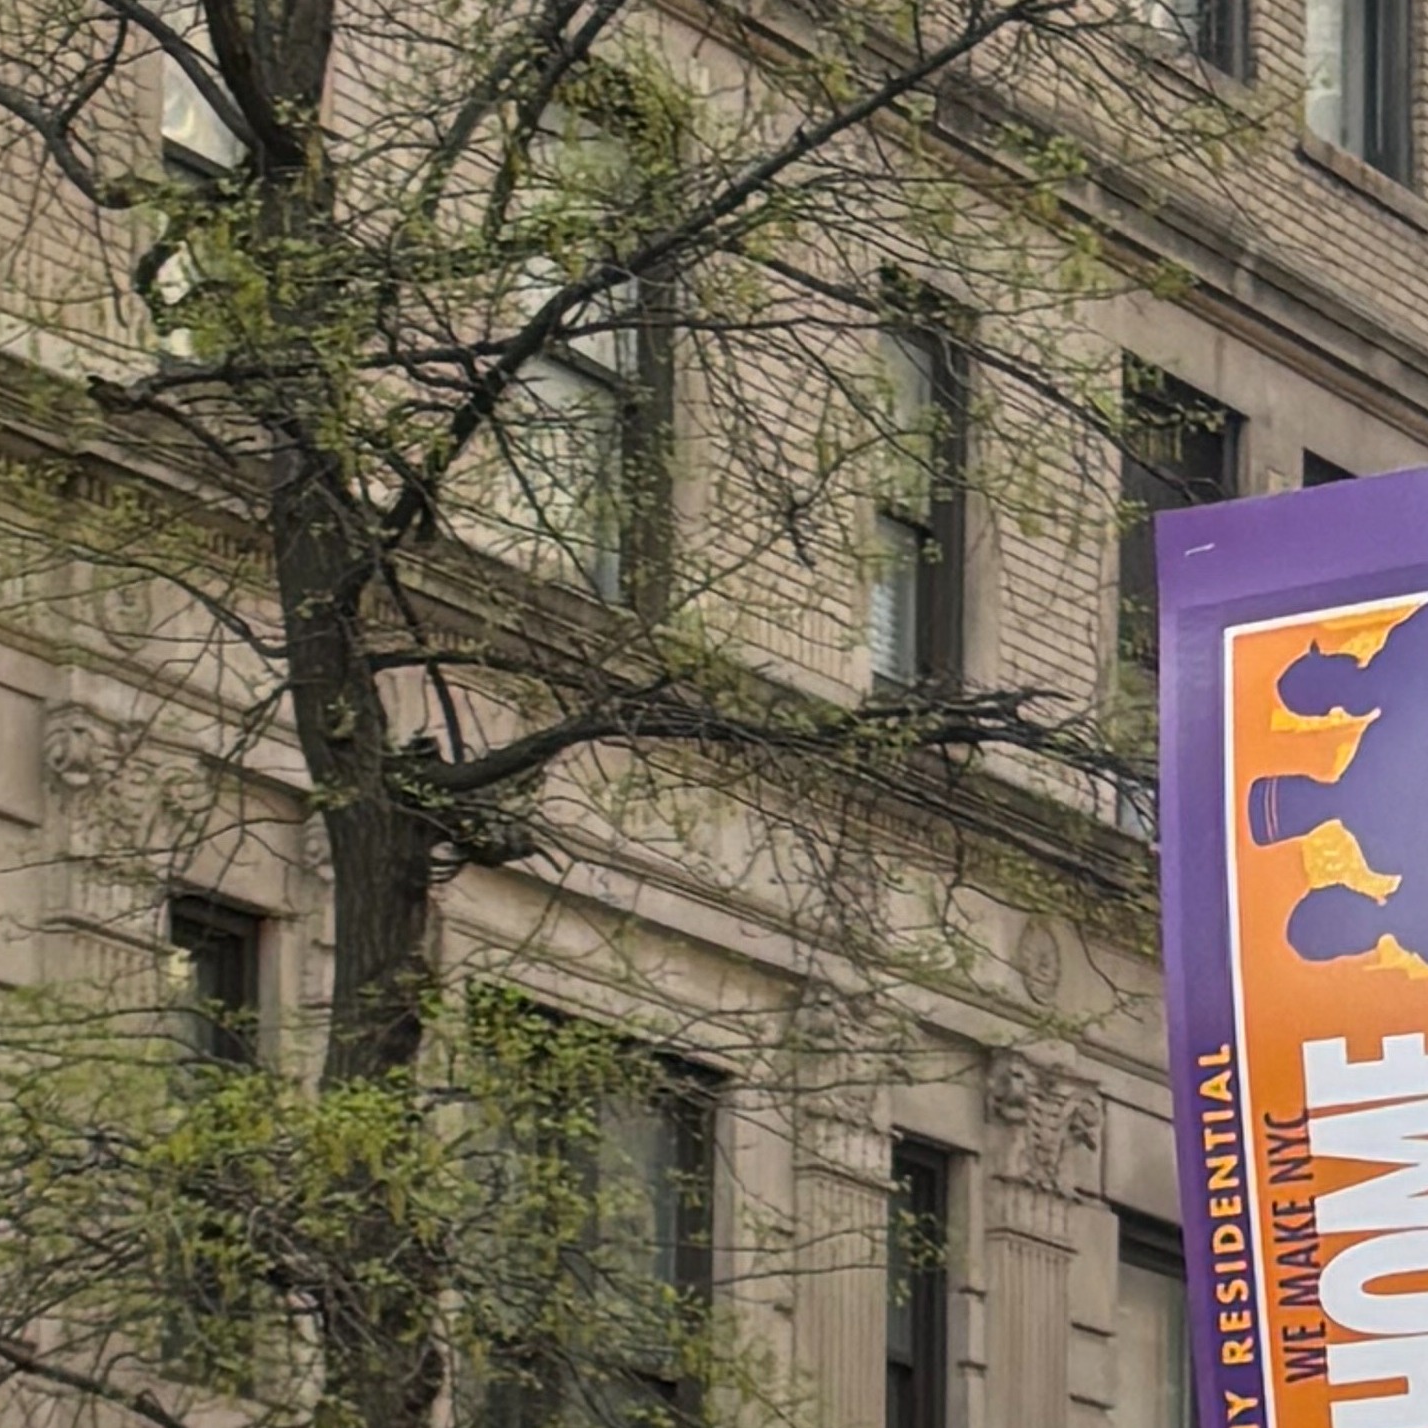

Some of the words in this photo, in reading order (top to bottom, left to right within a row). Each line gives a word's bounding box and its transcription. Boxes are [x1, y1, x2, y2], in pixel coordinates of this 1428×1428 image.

[1265, 1107, 1314, 1186] NYC
[1198, 1043, 1255, 1366] RESIDENTIAL
[1273, 1195, 1321, 1313] MAKE
[1282, 1320, 1328, 1384] WE
